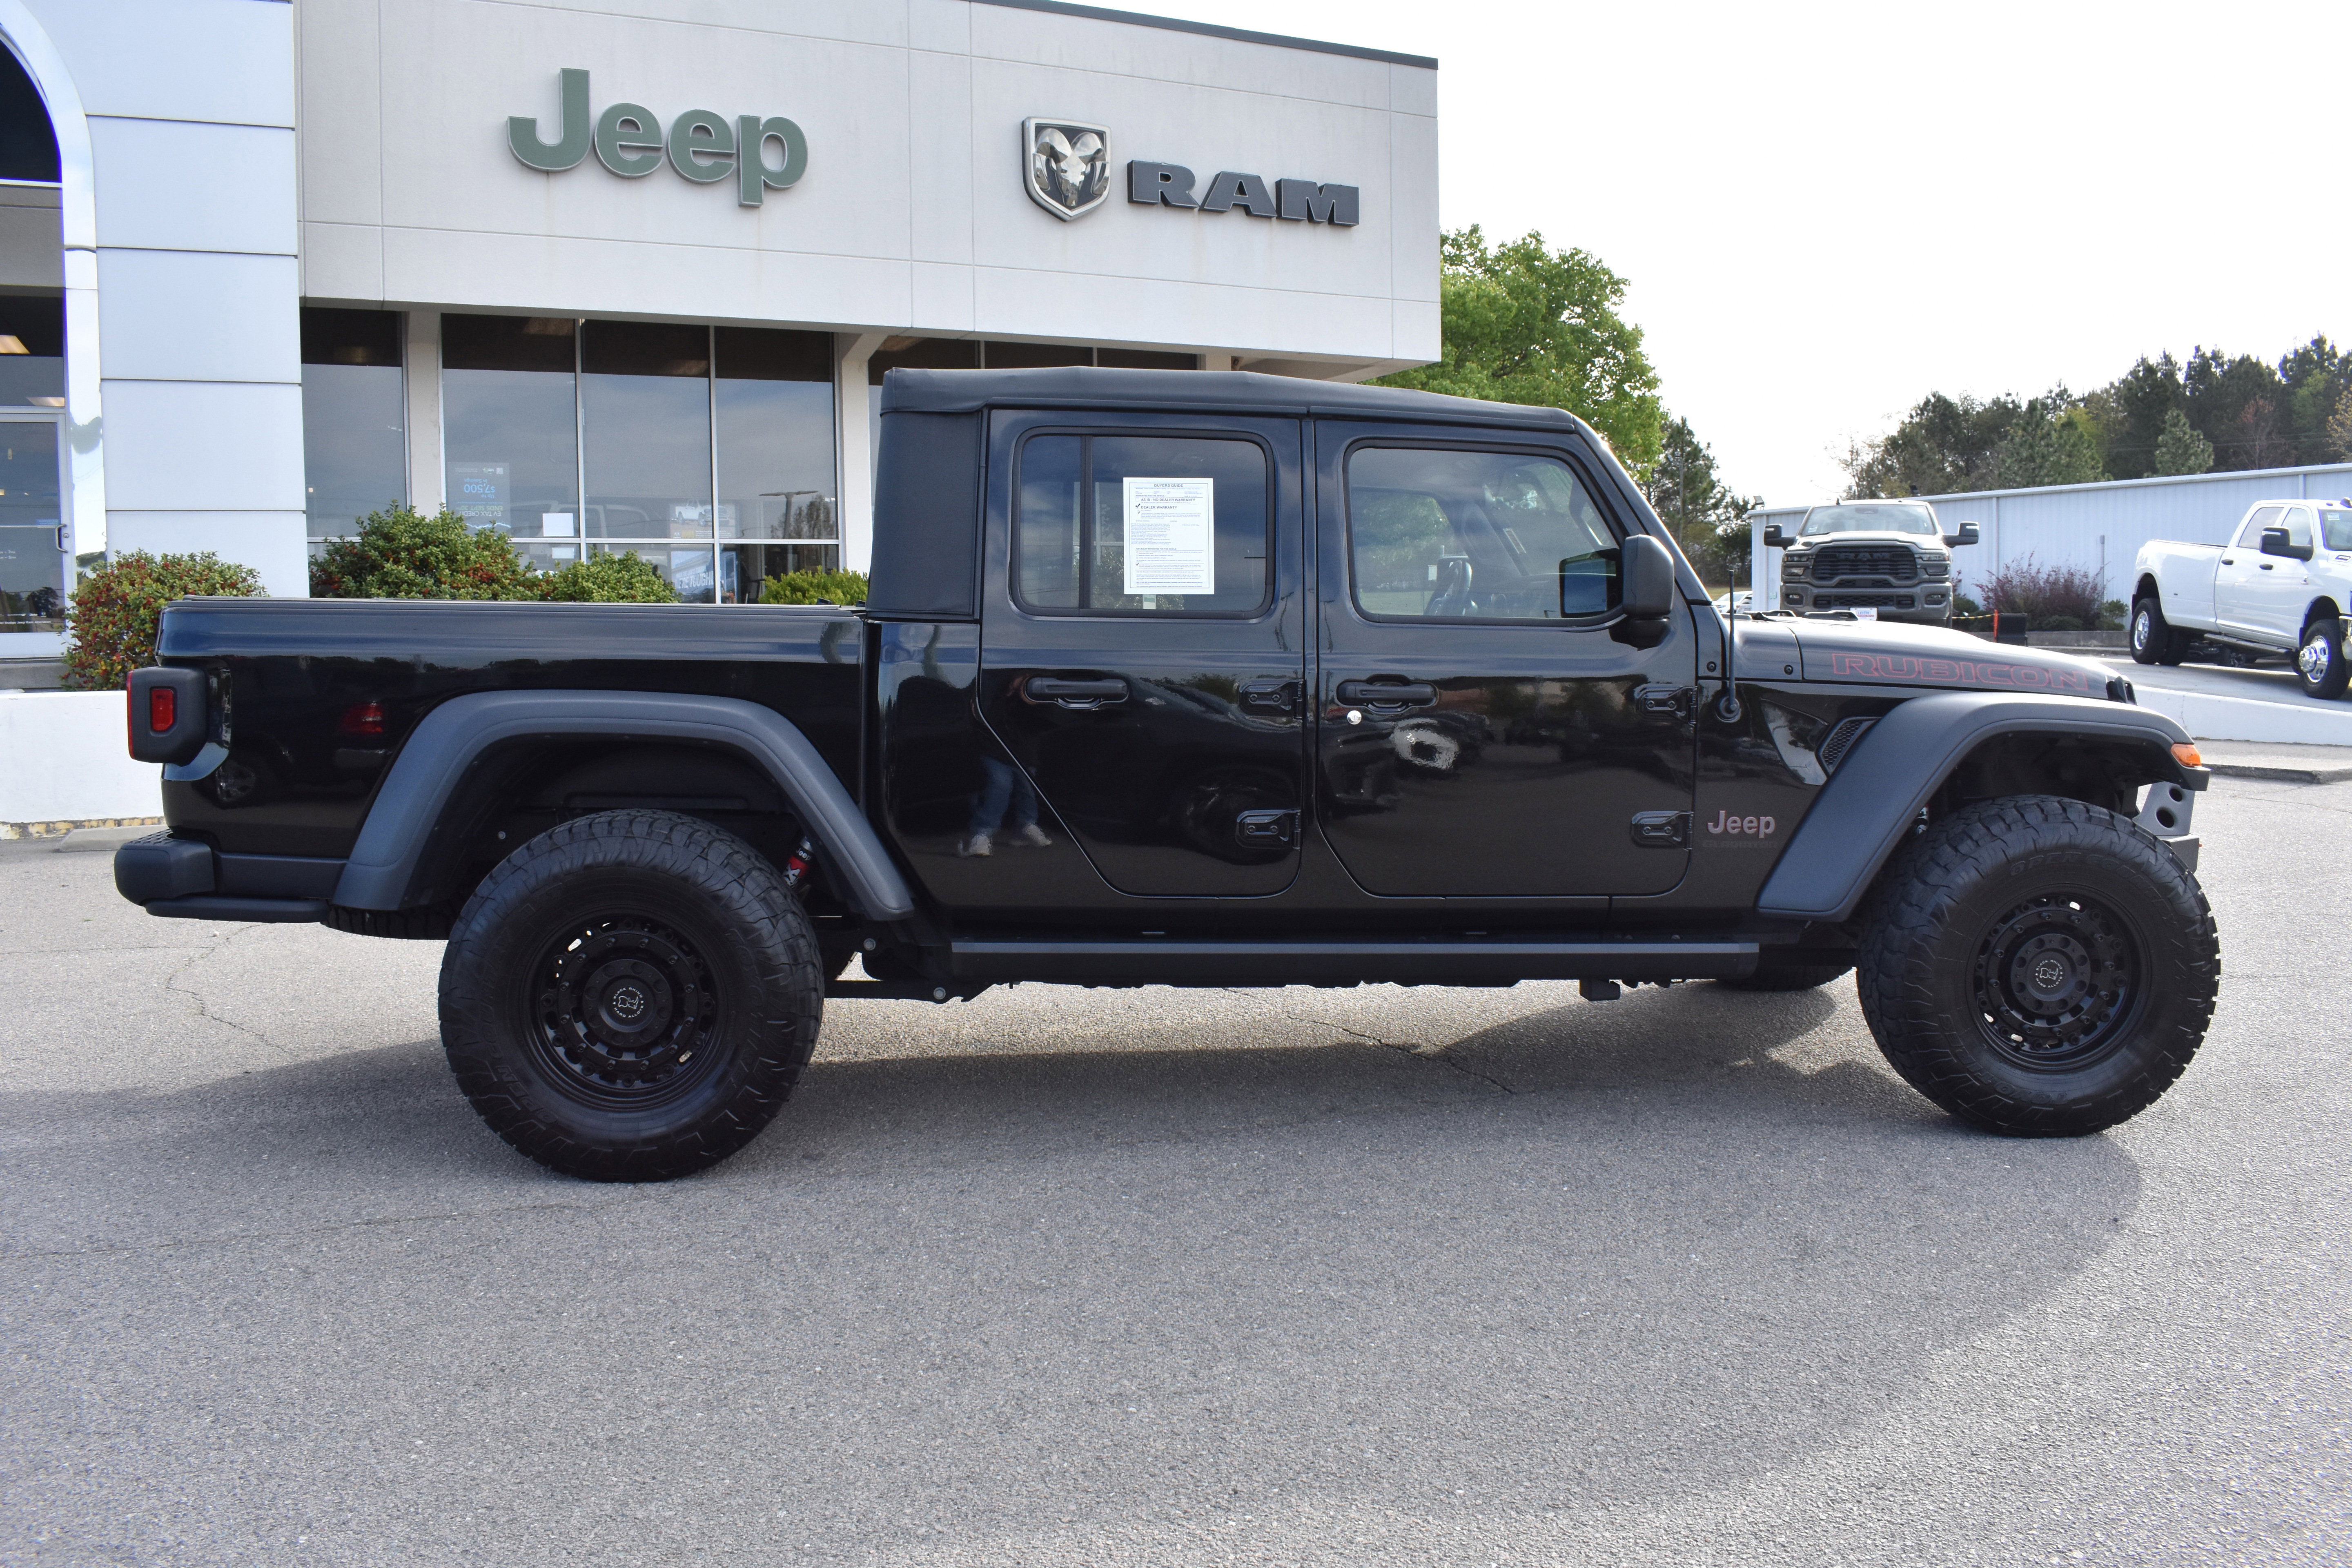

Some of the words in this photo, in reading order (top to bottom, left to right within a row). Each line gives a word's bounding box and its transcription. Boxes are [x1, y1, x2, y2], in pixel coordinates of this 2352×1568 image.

[507, 68, 808, 207] Jeep
[1127, 160, 1359, 227] RAM
[463, 483, 495, 493] $7,500
[1832, 654, 2088, 690] RUBICON
[1707, 811, 1775, 838] Jeep
[796, 848, 811, 861] Jeep
[2009, 852, 2082, 875] OPEN
[2035, 960, 2048, 971] BLACK
[613, 987, 626, 999] BLACK
[628, 987, 643, 998] RHINO
[614, 1007, 626, 1018] HARD
[628, 1005, 644, 1018] ALLOYS
